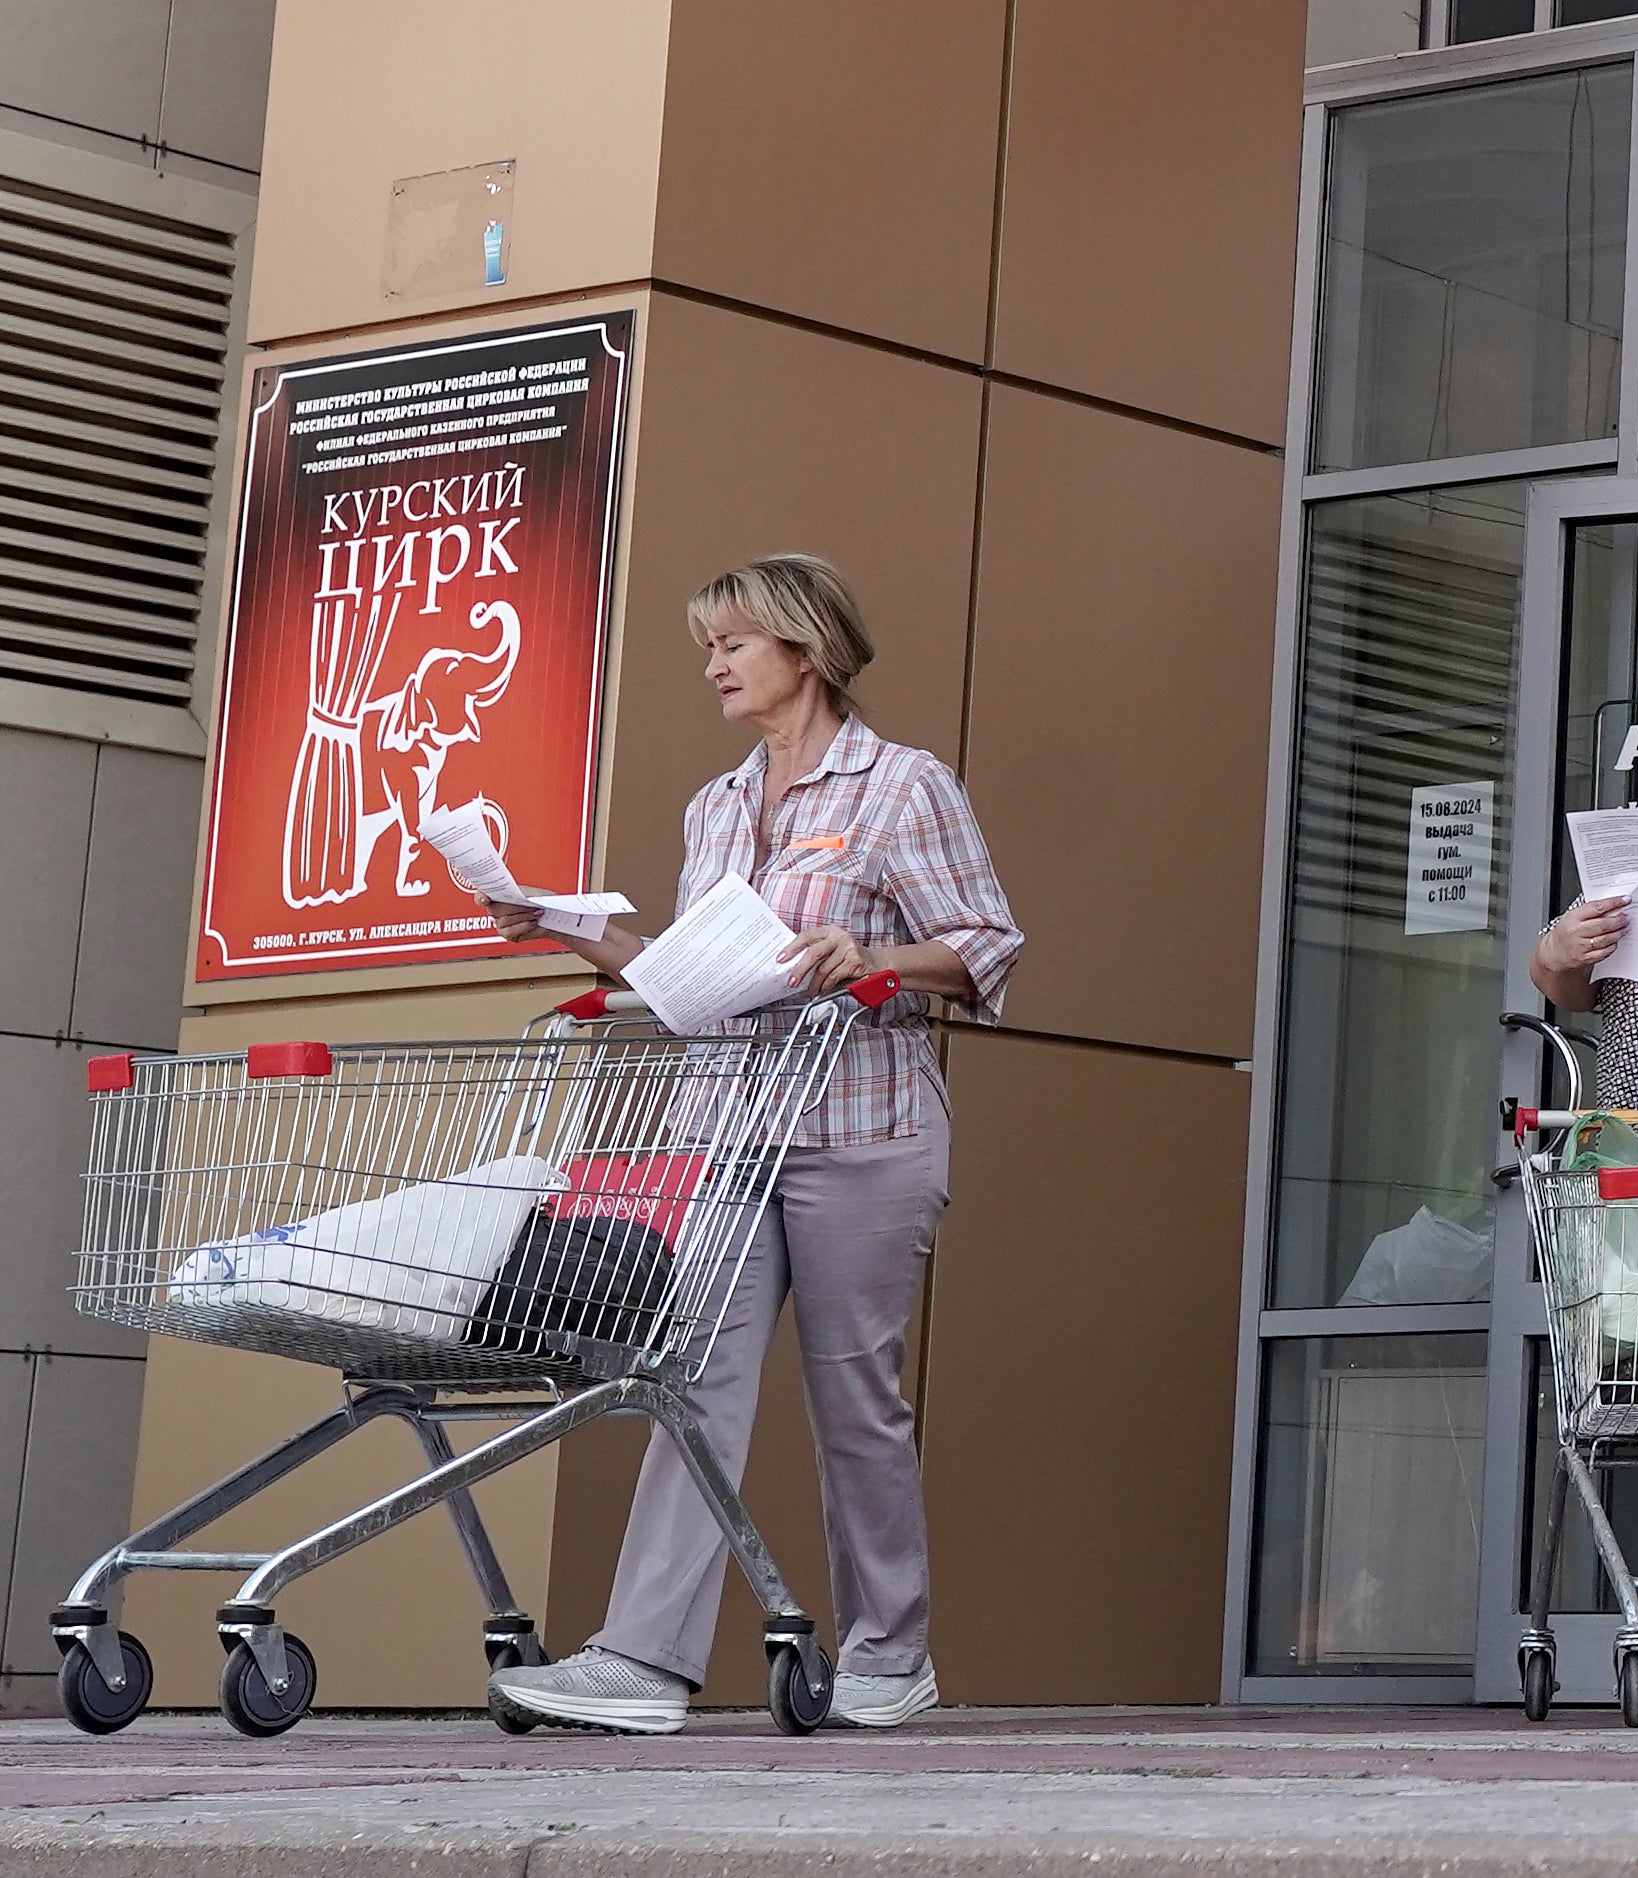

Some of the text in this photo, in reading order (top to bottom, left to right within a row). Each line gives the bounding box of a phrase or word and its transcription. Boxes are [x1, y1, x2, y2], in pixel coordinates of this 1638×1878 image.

[296, 358, 587, 414] МИНИСТЕРСТВО КУЛЬТУРЫ РОССИЙСКОЙ ФЕДЕРАЦИИ
[289, 378, 590, 435] РОССИЙСКАЯ ГОСУДАРСТВЕННАЯ ЦИРКОВАЯ КОМПАНИЯ
[315, 405, 556, 452] ФИЛИАЛ ФЕДЕРАЛЬНОГО КАЗЕННОГО ПРЕДПРИЯТИЯ
[366, 441, 456, 466] ГОСУДАРСТВЕННАЯ
[457, 431, 508, 452] ЦИРКОВАЯ
[321, 461, 526, 538] КУРСКИЙ
[1420, 799, 1481, 818] 15.08.2024
[1437, 846, 1462, 860] гум.
[1422, 865, 1473, 881] помощи
[1439, 885, 1466, 902] 11:00
[369, 920, 441, 940] АЛЕКСАНДРА
[443, 916, 497, 933] НЕВСКОГ
